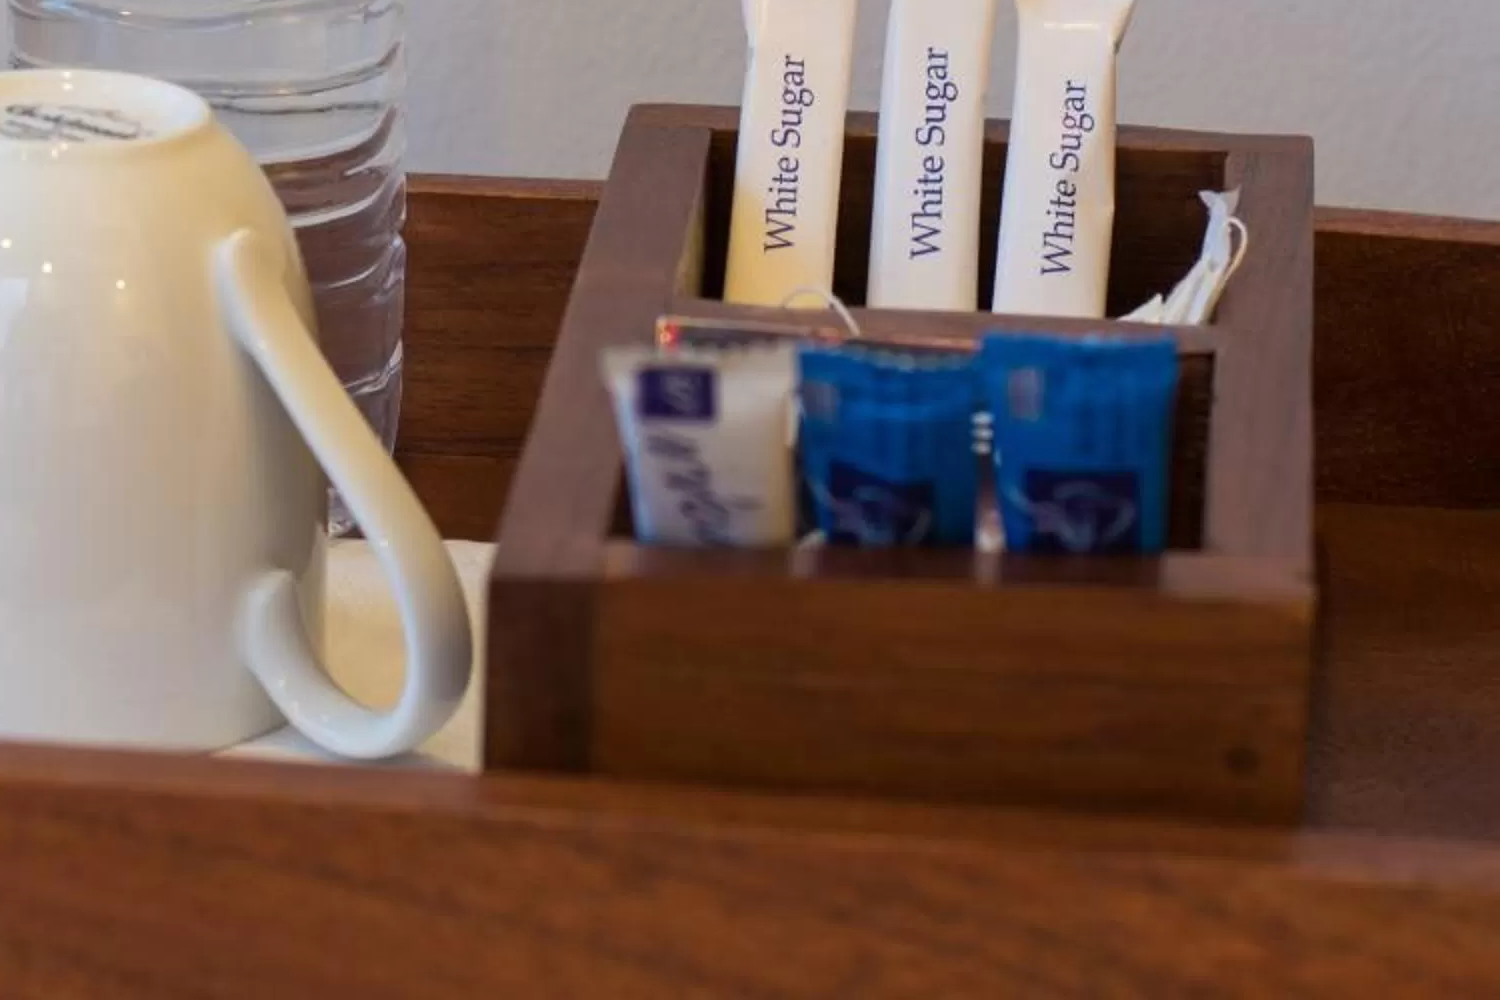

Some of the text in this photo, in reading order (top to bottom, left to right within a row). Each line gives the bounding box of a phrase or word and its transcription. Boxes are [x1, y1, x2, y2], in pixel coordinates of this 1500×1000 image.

[763, 54, 815, 255] White Sugar
[909, 47, 959, 260] White Sugar
[1039, 80, 1096, 276] White Sugar
